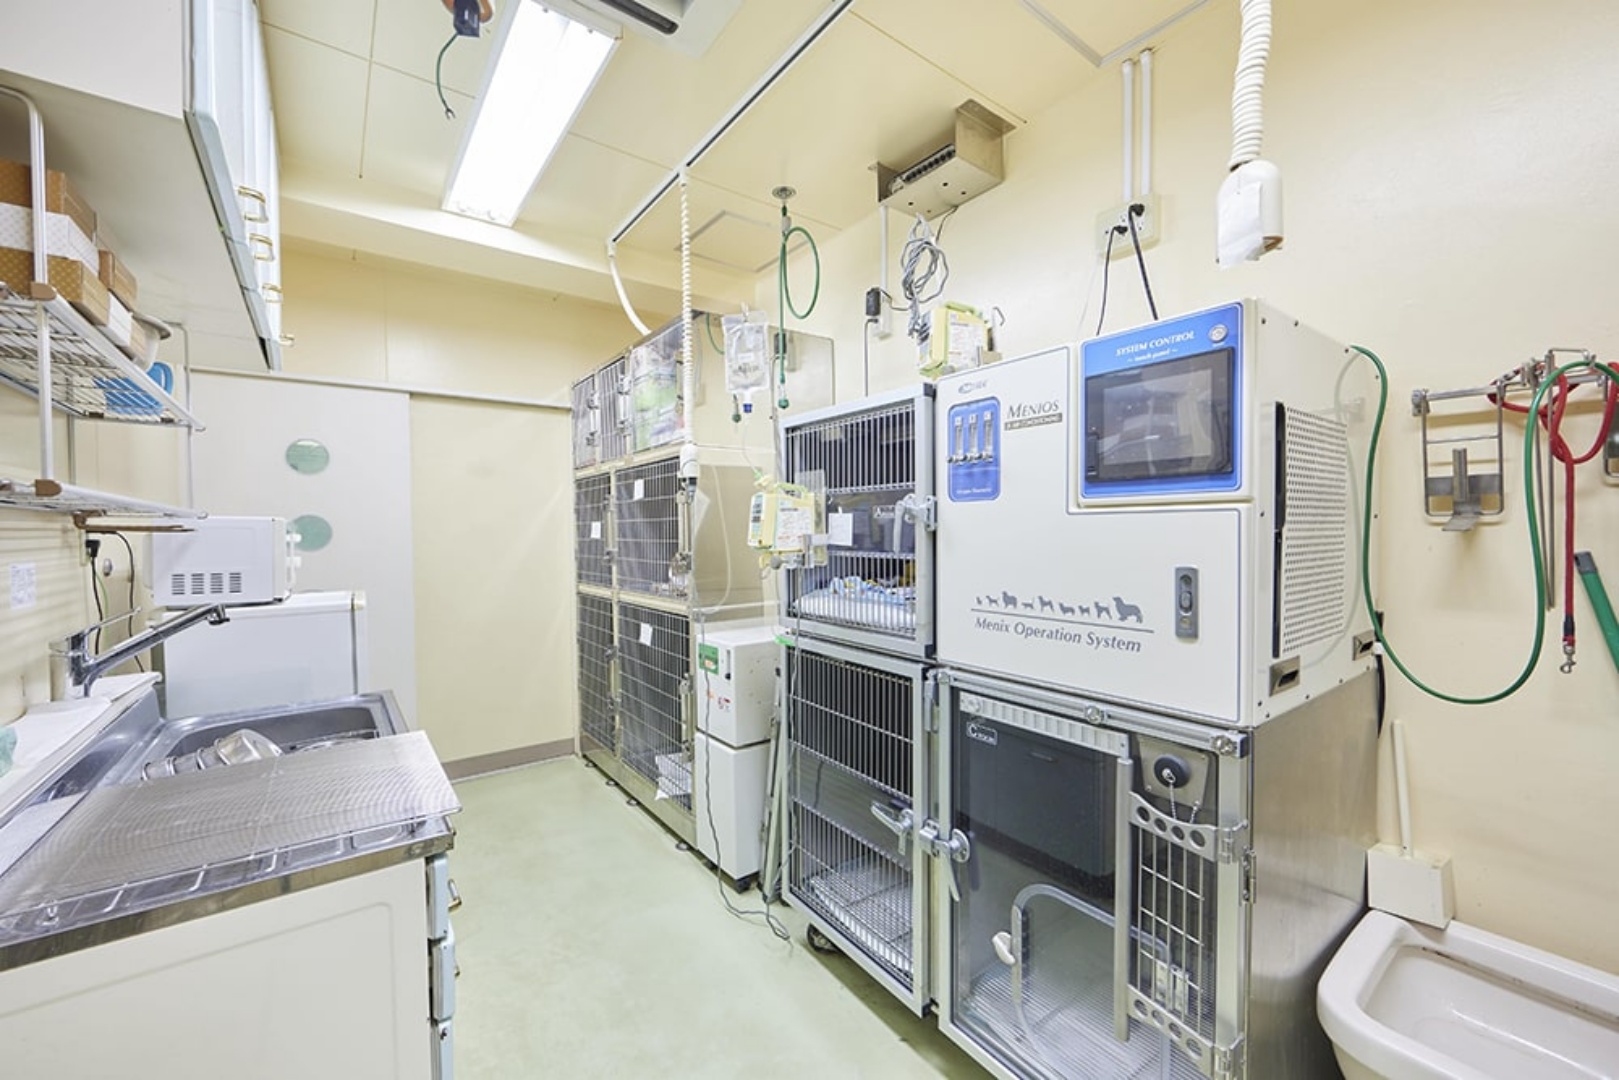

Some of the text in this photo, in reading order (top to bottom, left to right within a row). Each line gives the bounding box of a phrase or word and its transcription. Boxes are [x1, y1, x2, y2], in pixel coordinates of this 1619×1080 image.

[1115, 330, 1195, 357] SYSTEM CONTROL
[974, 616, 1142, 653] Menix Operation System
